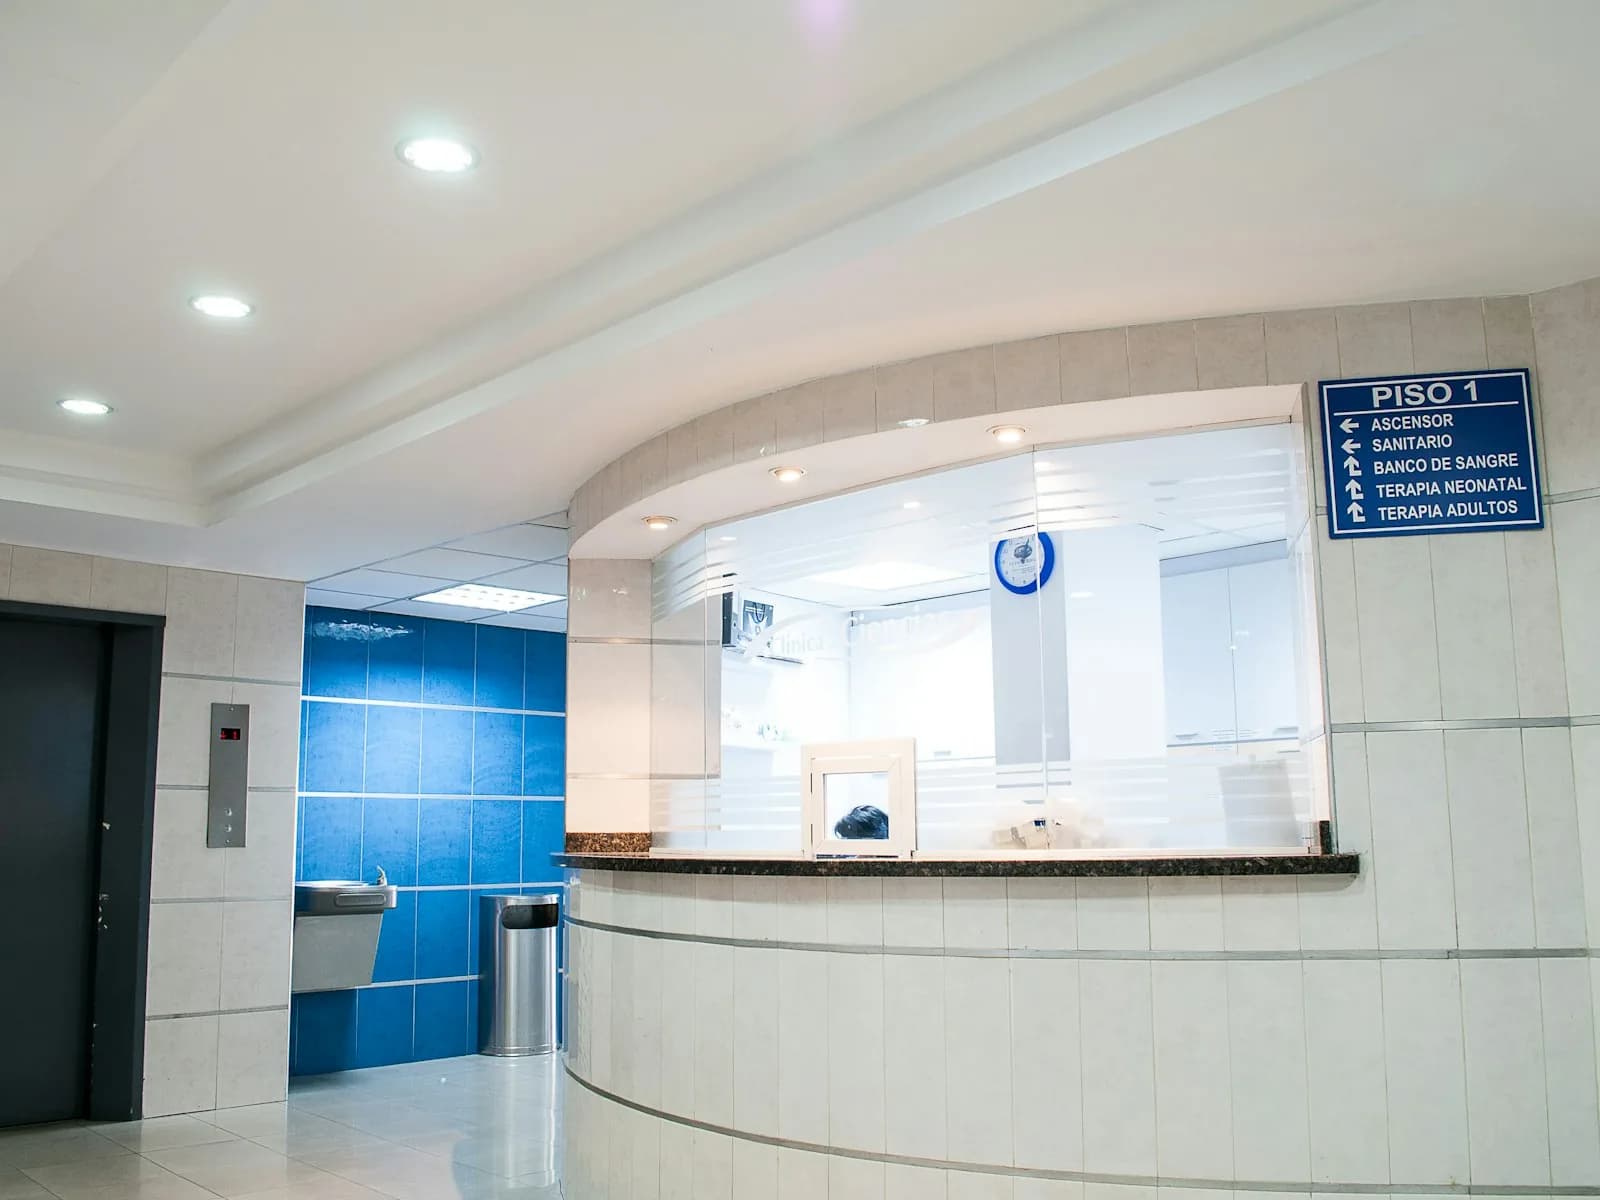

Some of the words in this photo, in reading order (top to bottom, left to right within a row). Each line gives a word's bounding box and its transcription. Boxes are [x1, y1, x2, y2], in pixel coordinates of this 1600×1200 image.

[1372, 383, 1452, 408] PISO
[1464, 380, 1478, 401] 1
[1371, 414, 1453, 431] ASCENSOR
[1372, 434, 1453, 452] SANITARIO
[1373, 457, 1428, 475] BANCO
[1431, 456, 1452, 471] DE
[1455, 452, 1519, 470] SANGRE
[1376, 481, 1441, 498] TERAPIA
[1444, 476, 1527, 494] NEONATAL
[1377, 503, 1443, 521] TERAPIA
[1446, 500, 1519, 517] ADULTOS
